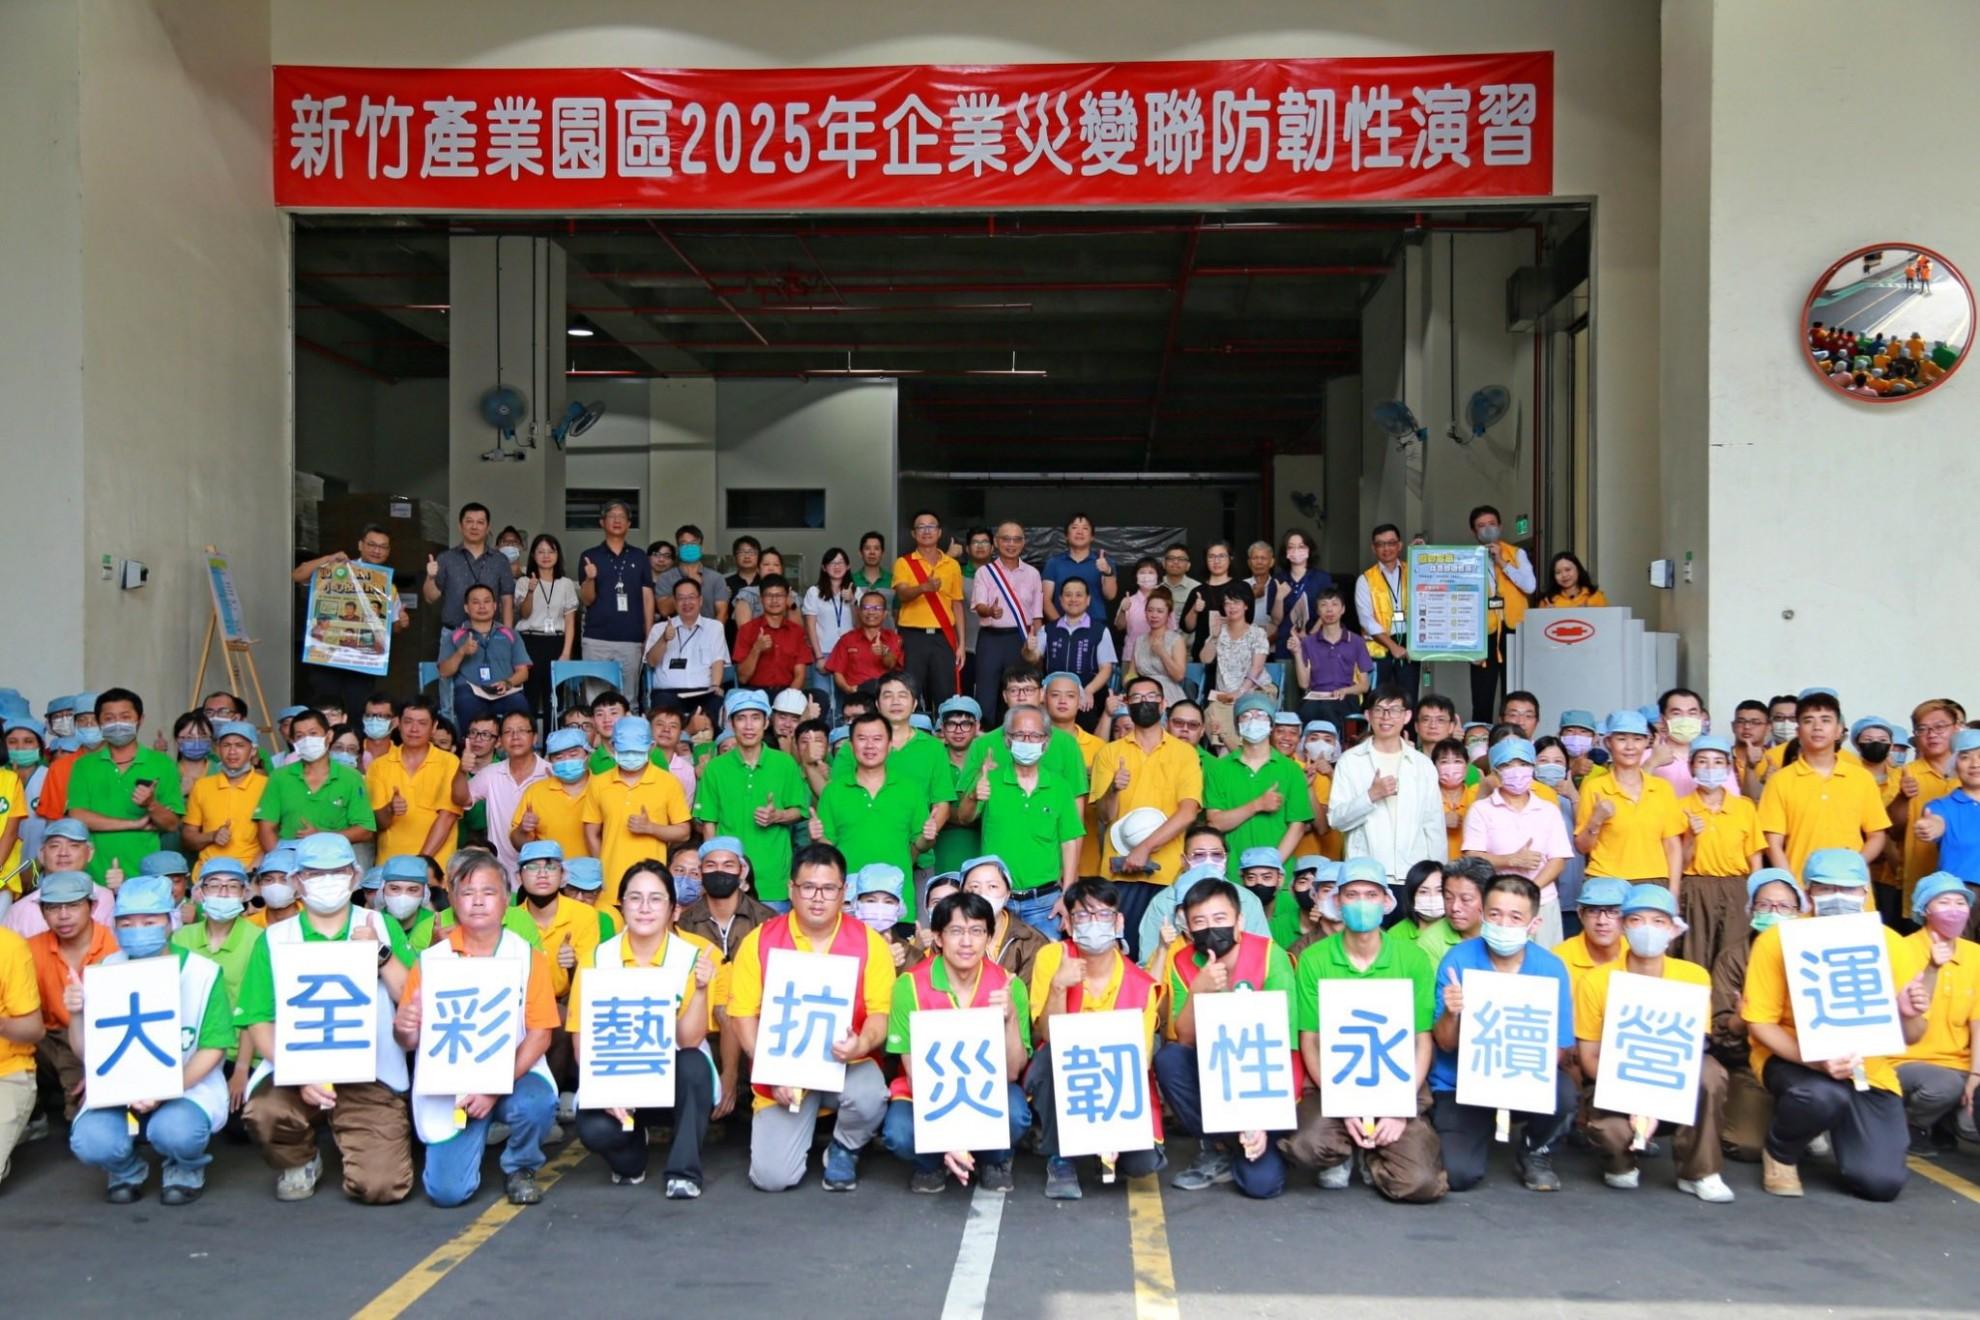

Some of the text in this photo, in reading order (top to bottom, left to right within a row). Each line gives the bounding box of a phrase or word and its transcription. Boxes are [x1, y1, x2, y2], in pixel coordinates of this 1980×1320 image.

[291, 83, 1535, 181] 新竹產業園區2025年企業災變聯防韌性演習
[287, 974, 370, 1051] 全
[430, 988, 511, 1064] 彩
[769, 981, 845, 1061] 抗
[1799, 944, 1891, 1029] 運
[95, 992, 176, 1077] 大
[592, 996, 673, 1076] 藝
[1210, 1023, 1288, 1101] 性
[1331, 1009, 1409, 1087] 永
[1472, 1002, 1551, 1081] 續
[1616, 1003, 1693, 1090] 營
[924, 1040, 1003, 1121] 災
[1062, 1044, 1143, 1123] 韌
